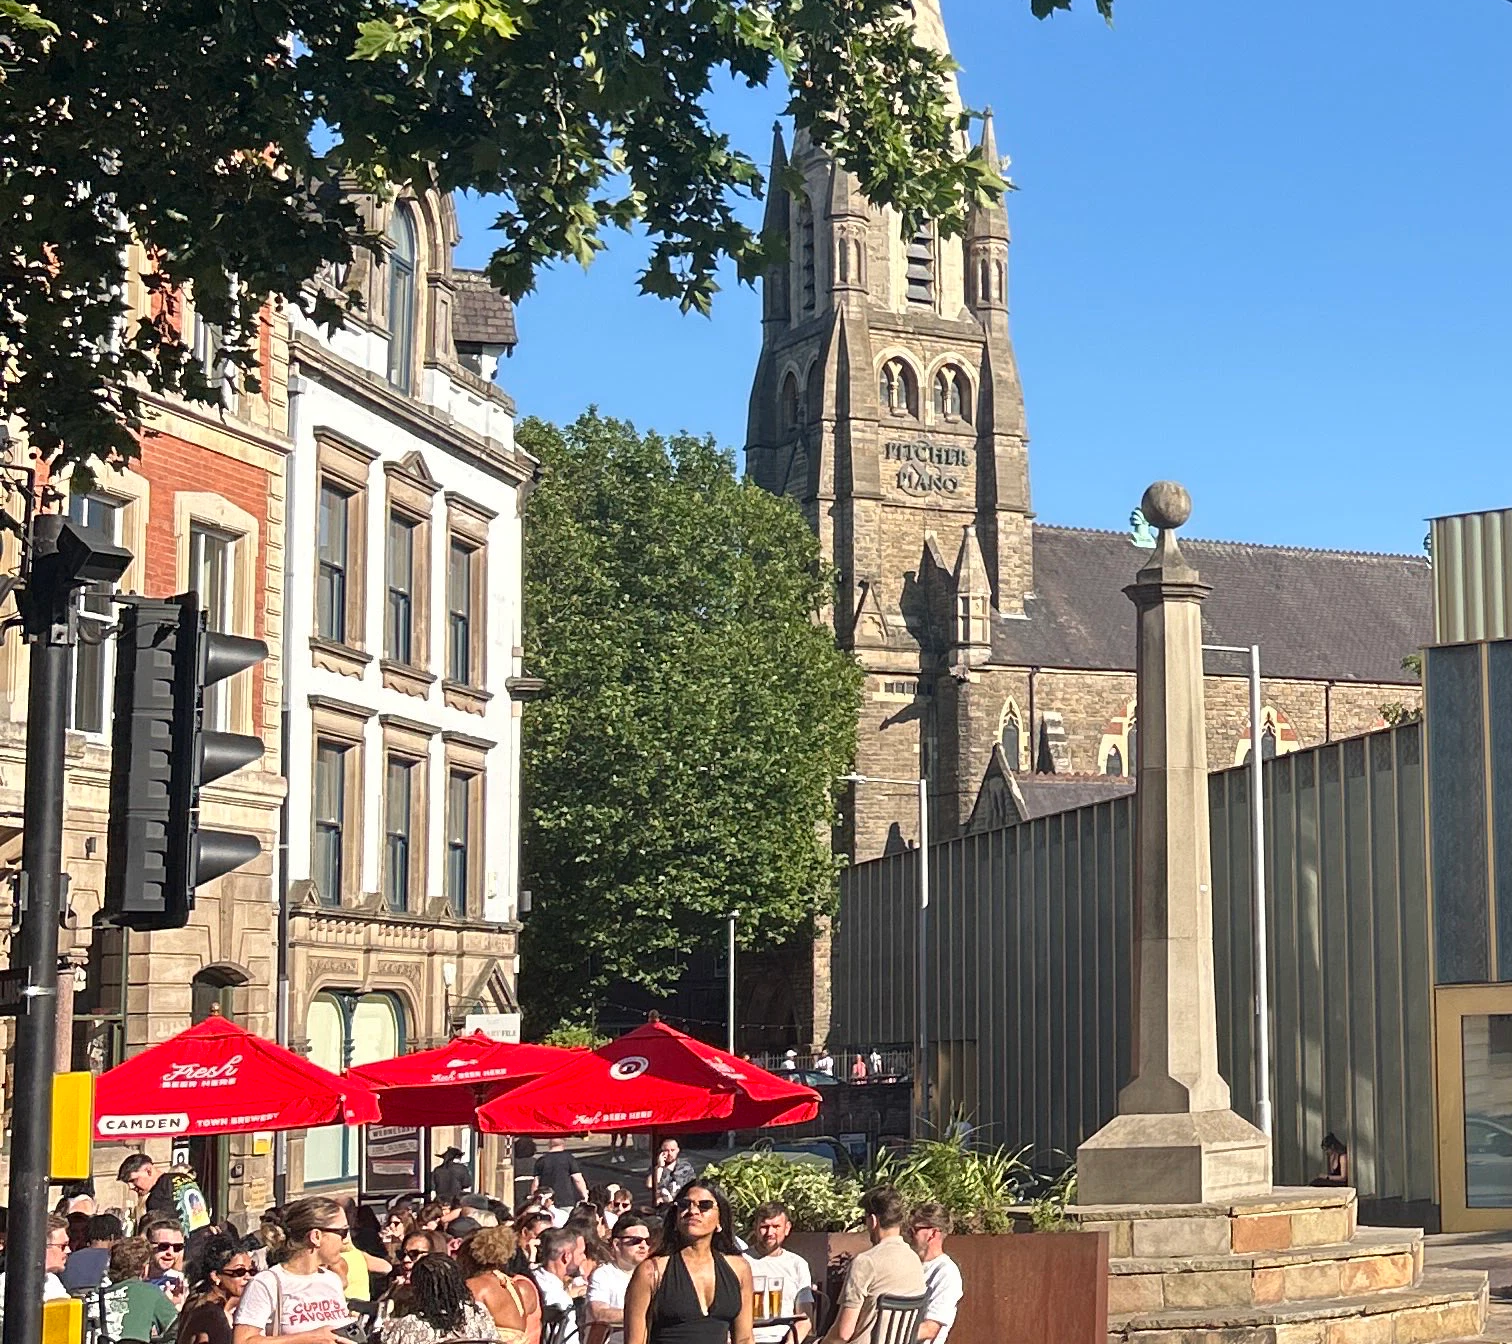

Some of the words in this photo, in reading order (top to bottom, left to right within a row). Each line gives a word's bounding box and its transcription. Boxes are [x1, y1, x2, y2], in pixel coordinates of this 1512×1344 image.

[884, 441, 971, 467] PITCHER
[896, 471, 957, 494] PIANO
[161, 1054, 243, 1081] Fresh
[161, 1080, 198, 1089] BEER
[201, 1077, 237, 1088] HERE
[106, 1118, 181, 1130] CAMDEN
[197, 1117, 228, 1128] TOWN
[231, 1112, 280, 1126] BREWERY
[293, 1299, 341, 1314] CUPID'S
